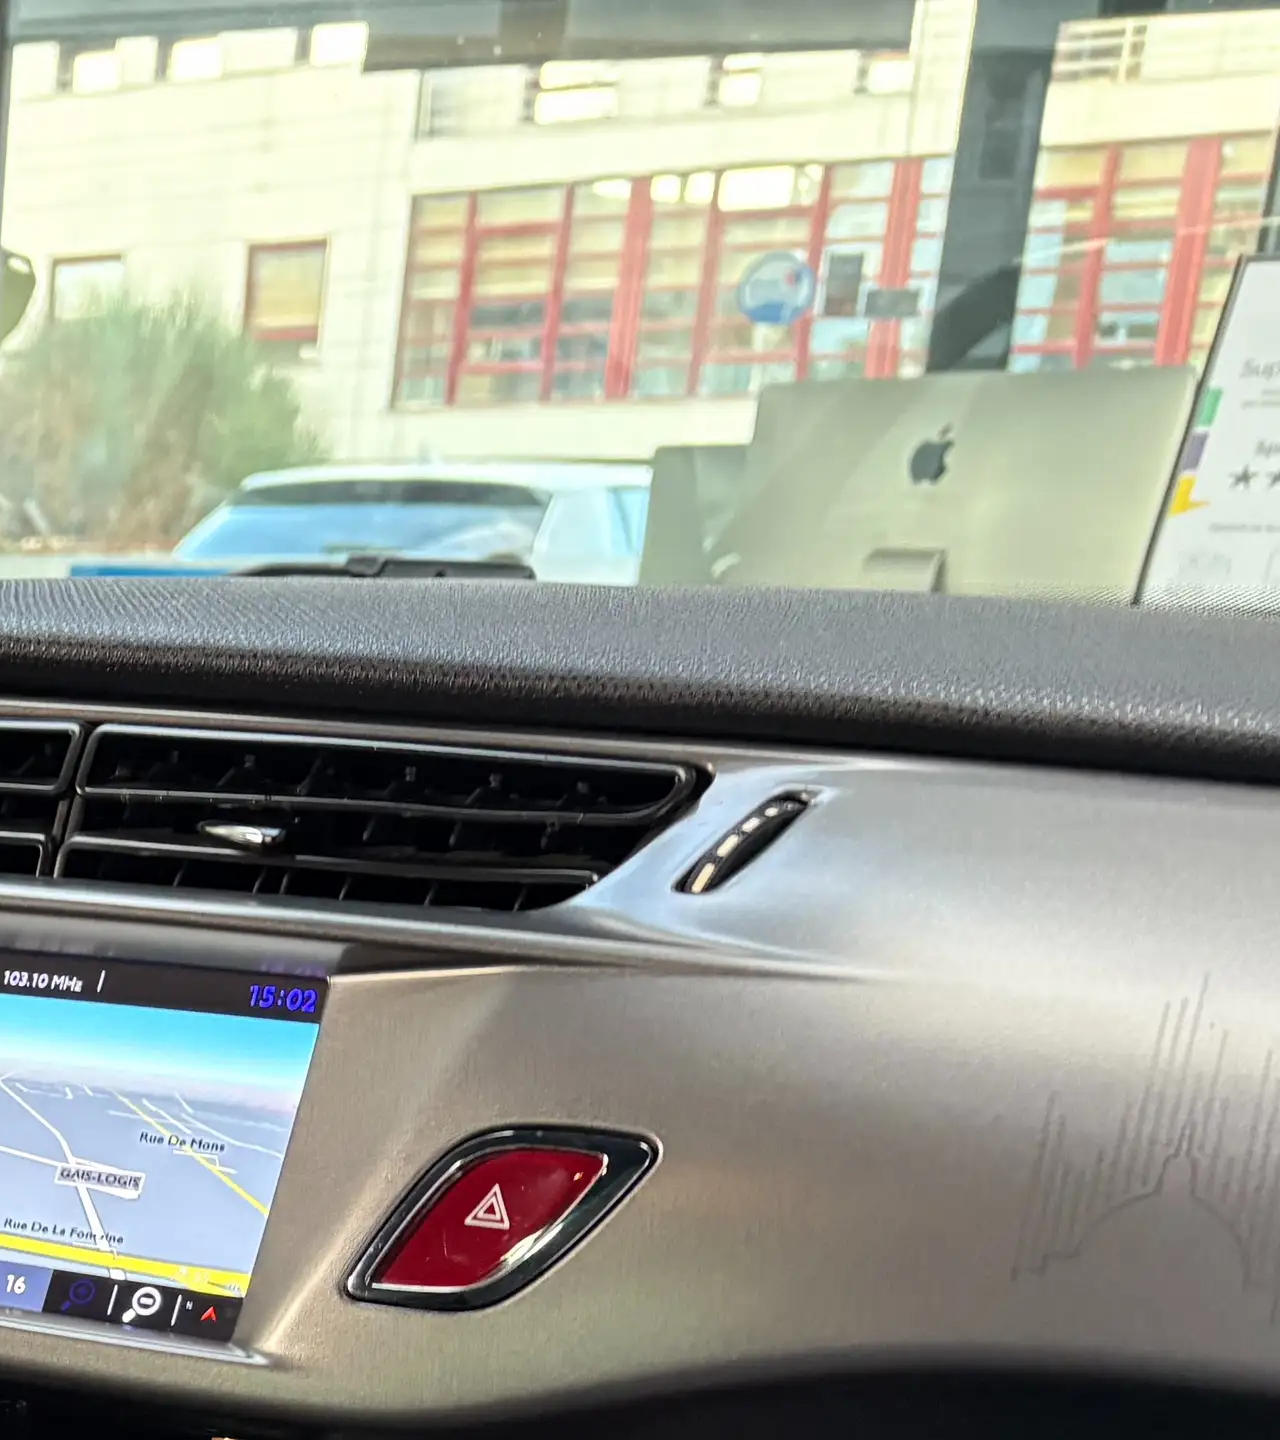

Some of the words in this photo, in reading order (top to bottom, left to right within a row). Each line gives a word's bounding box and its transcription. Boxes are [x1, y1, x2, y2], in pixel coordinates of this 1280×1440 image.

[3, 969, 50, 990] 103.10
[51, 974, 84, 993] MHz
[249, 984, 318, 1013] 15:02
[139, 1131, 164, 1145] Rue
[168, 1134, 186, 1147] De
[190, 1138, 226, 1152] Mons
[59, 1166, 143, 1191] GAIS-LOGIS
[3, 1217, 28, 1231] Rue
[31, 1222, 49, 1235] De
[52, 1224, 66, 1236] La
[6, 1274, 26, 1295] 16
